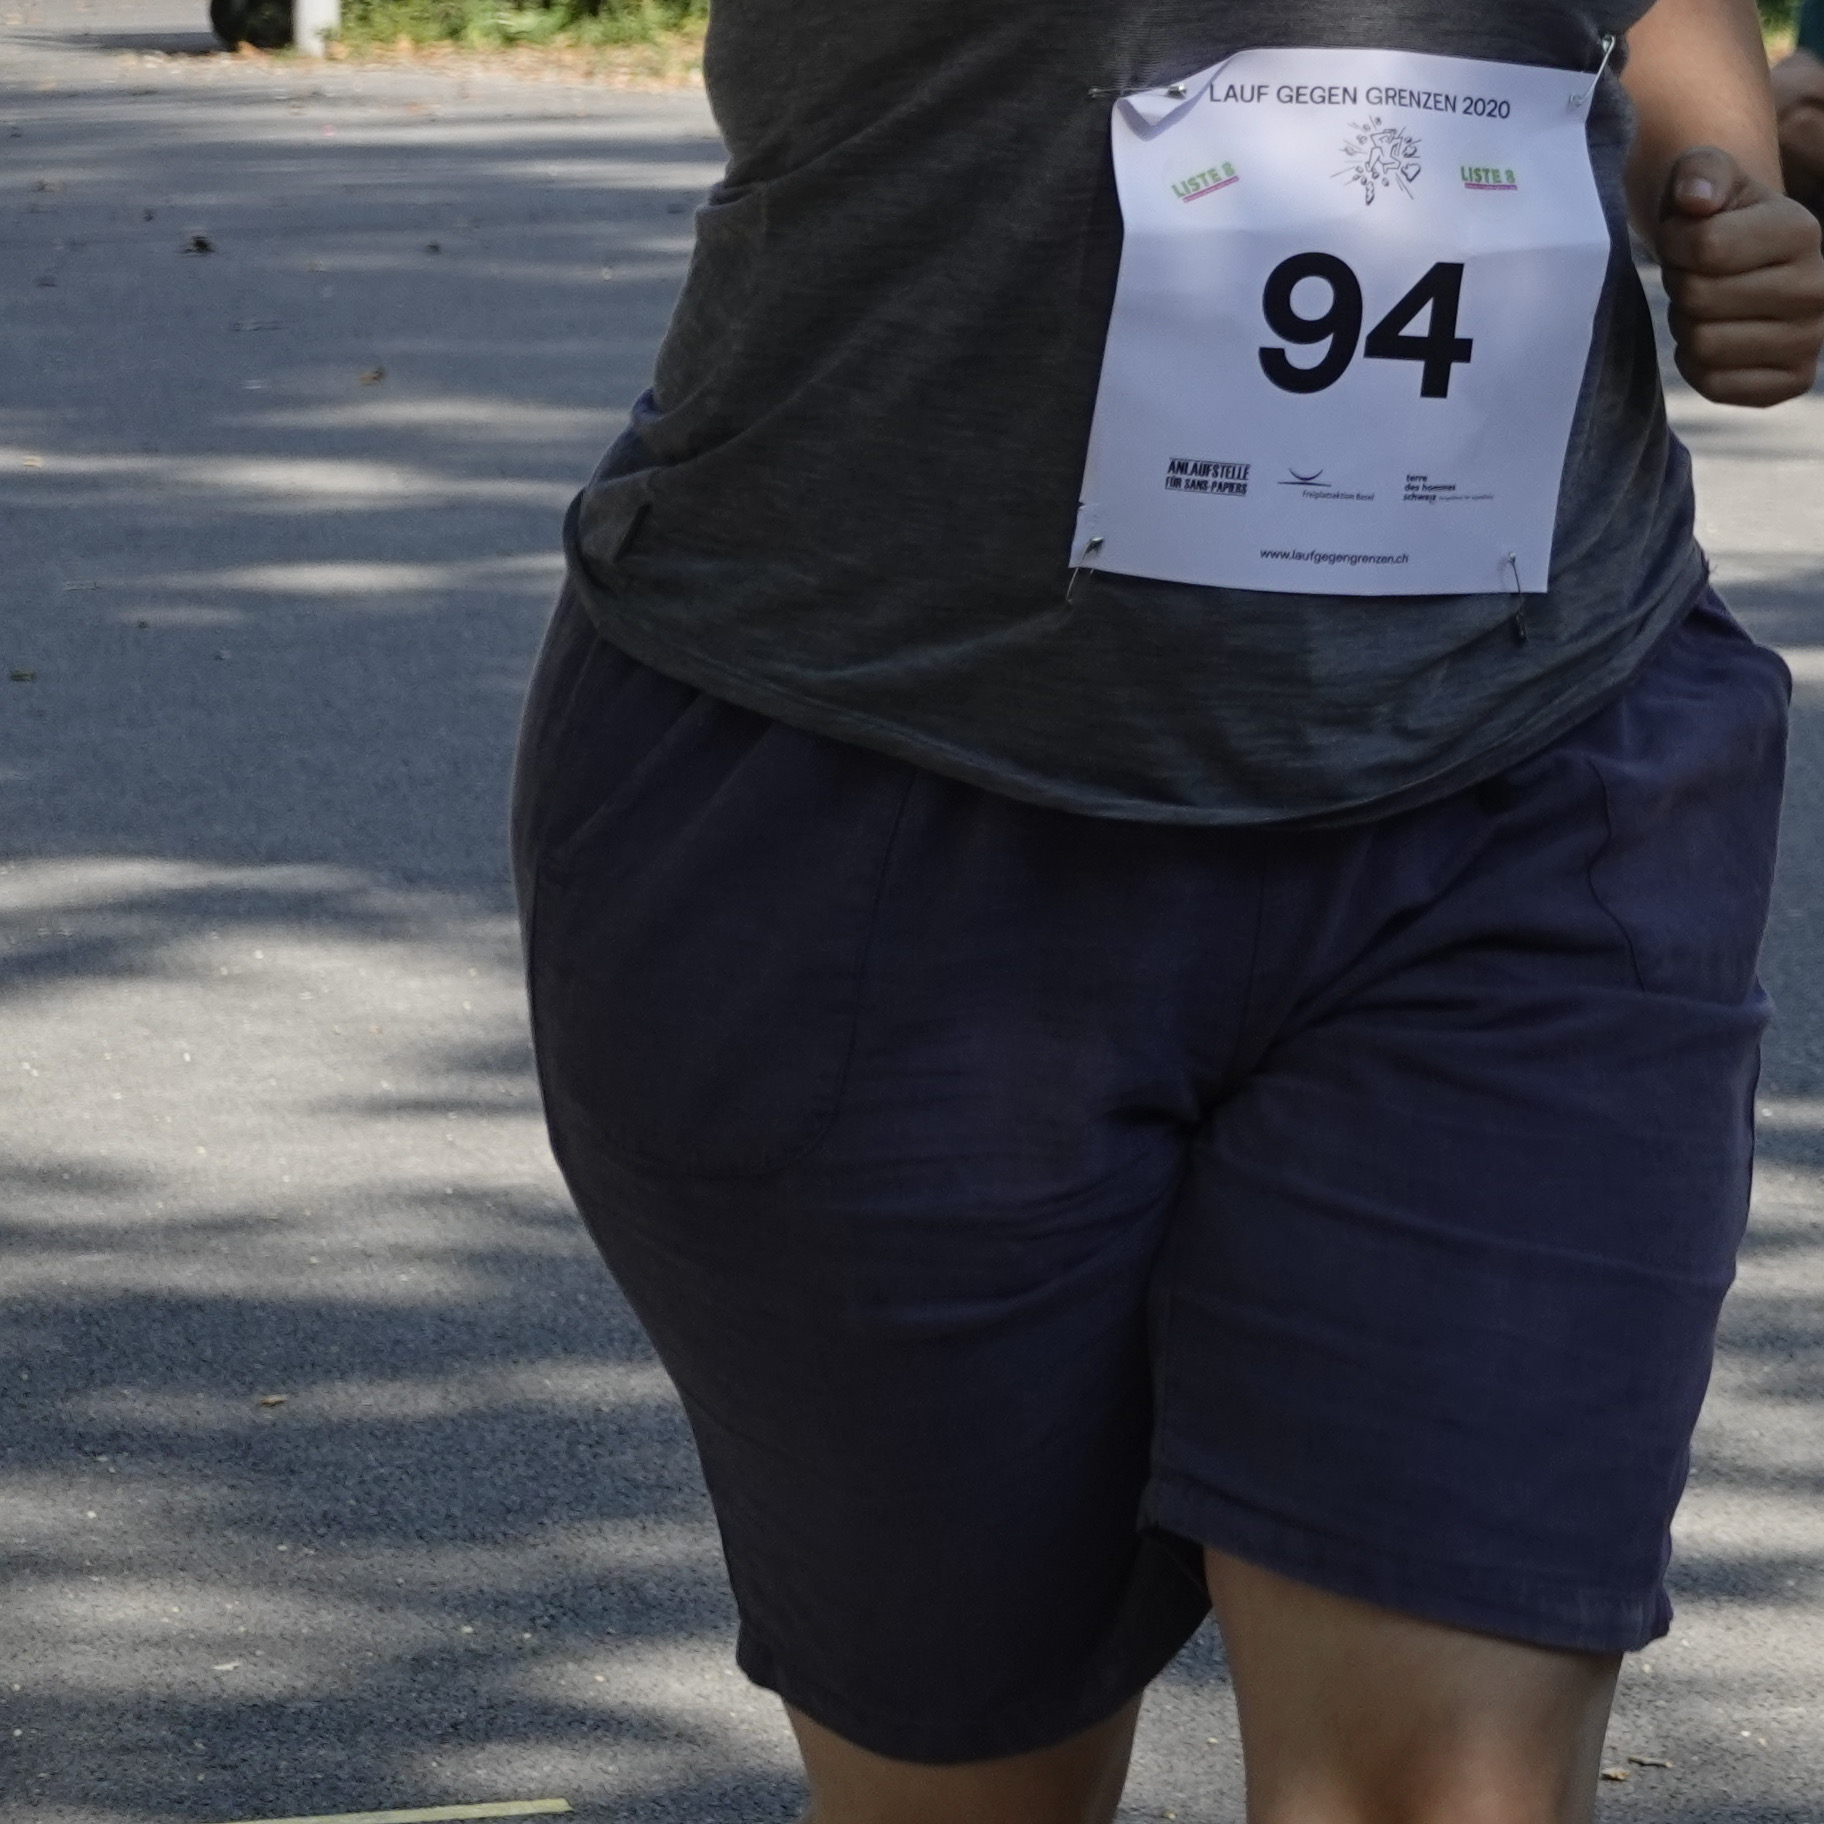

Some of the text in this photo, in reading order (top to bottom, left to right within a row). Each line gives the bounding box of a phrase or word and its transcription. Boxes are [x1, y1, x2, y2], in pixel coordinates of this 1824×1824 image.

[1209, 84, 1511, 119] LAUF GEGEN GRENZEN 2020
[1171, 161, 1237, 199] LISTE 8
[1460, 165, 1516, 184] LISTE 8
[1258, 252, 1473, 399] 94
[1167, 460, 1250, 480] ANLAUFSTELLE
[1165, 476, 1182, 489] FÜR
[1404, 483, 1419, 491] des
[1260, 549, 1409, 566] www.laufgegengrenzen.ch
